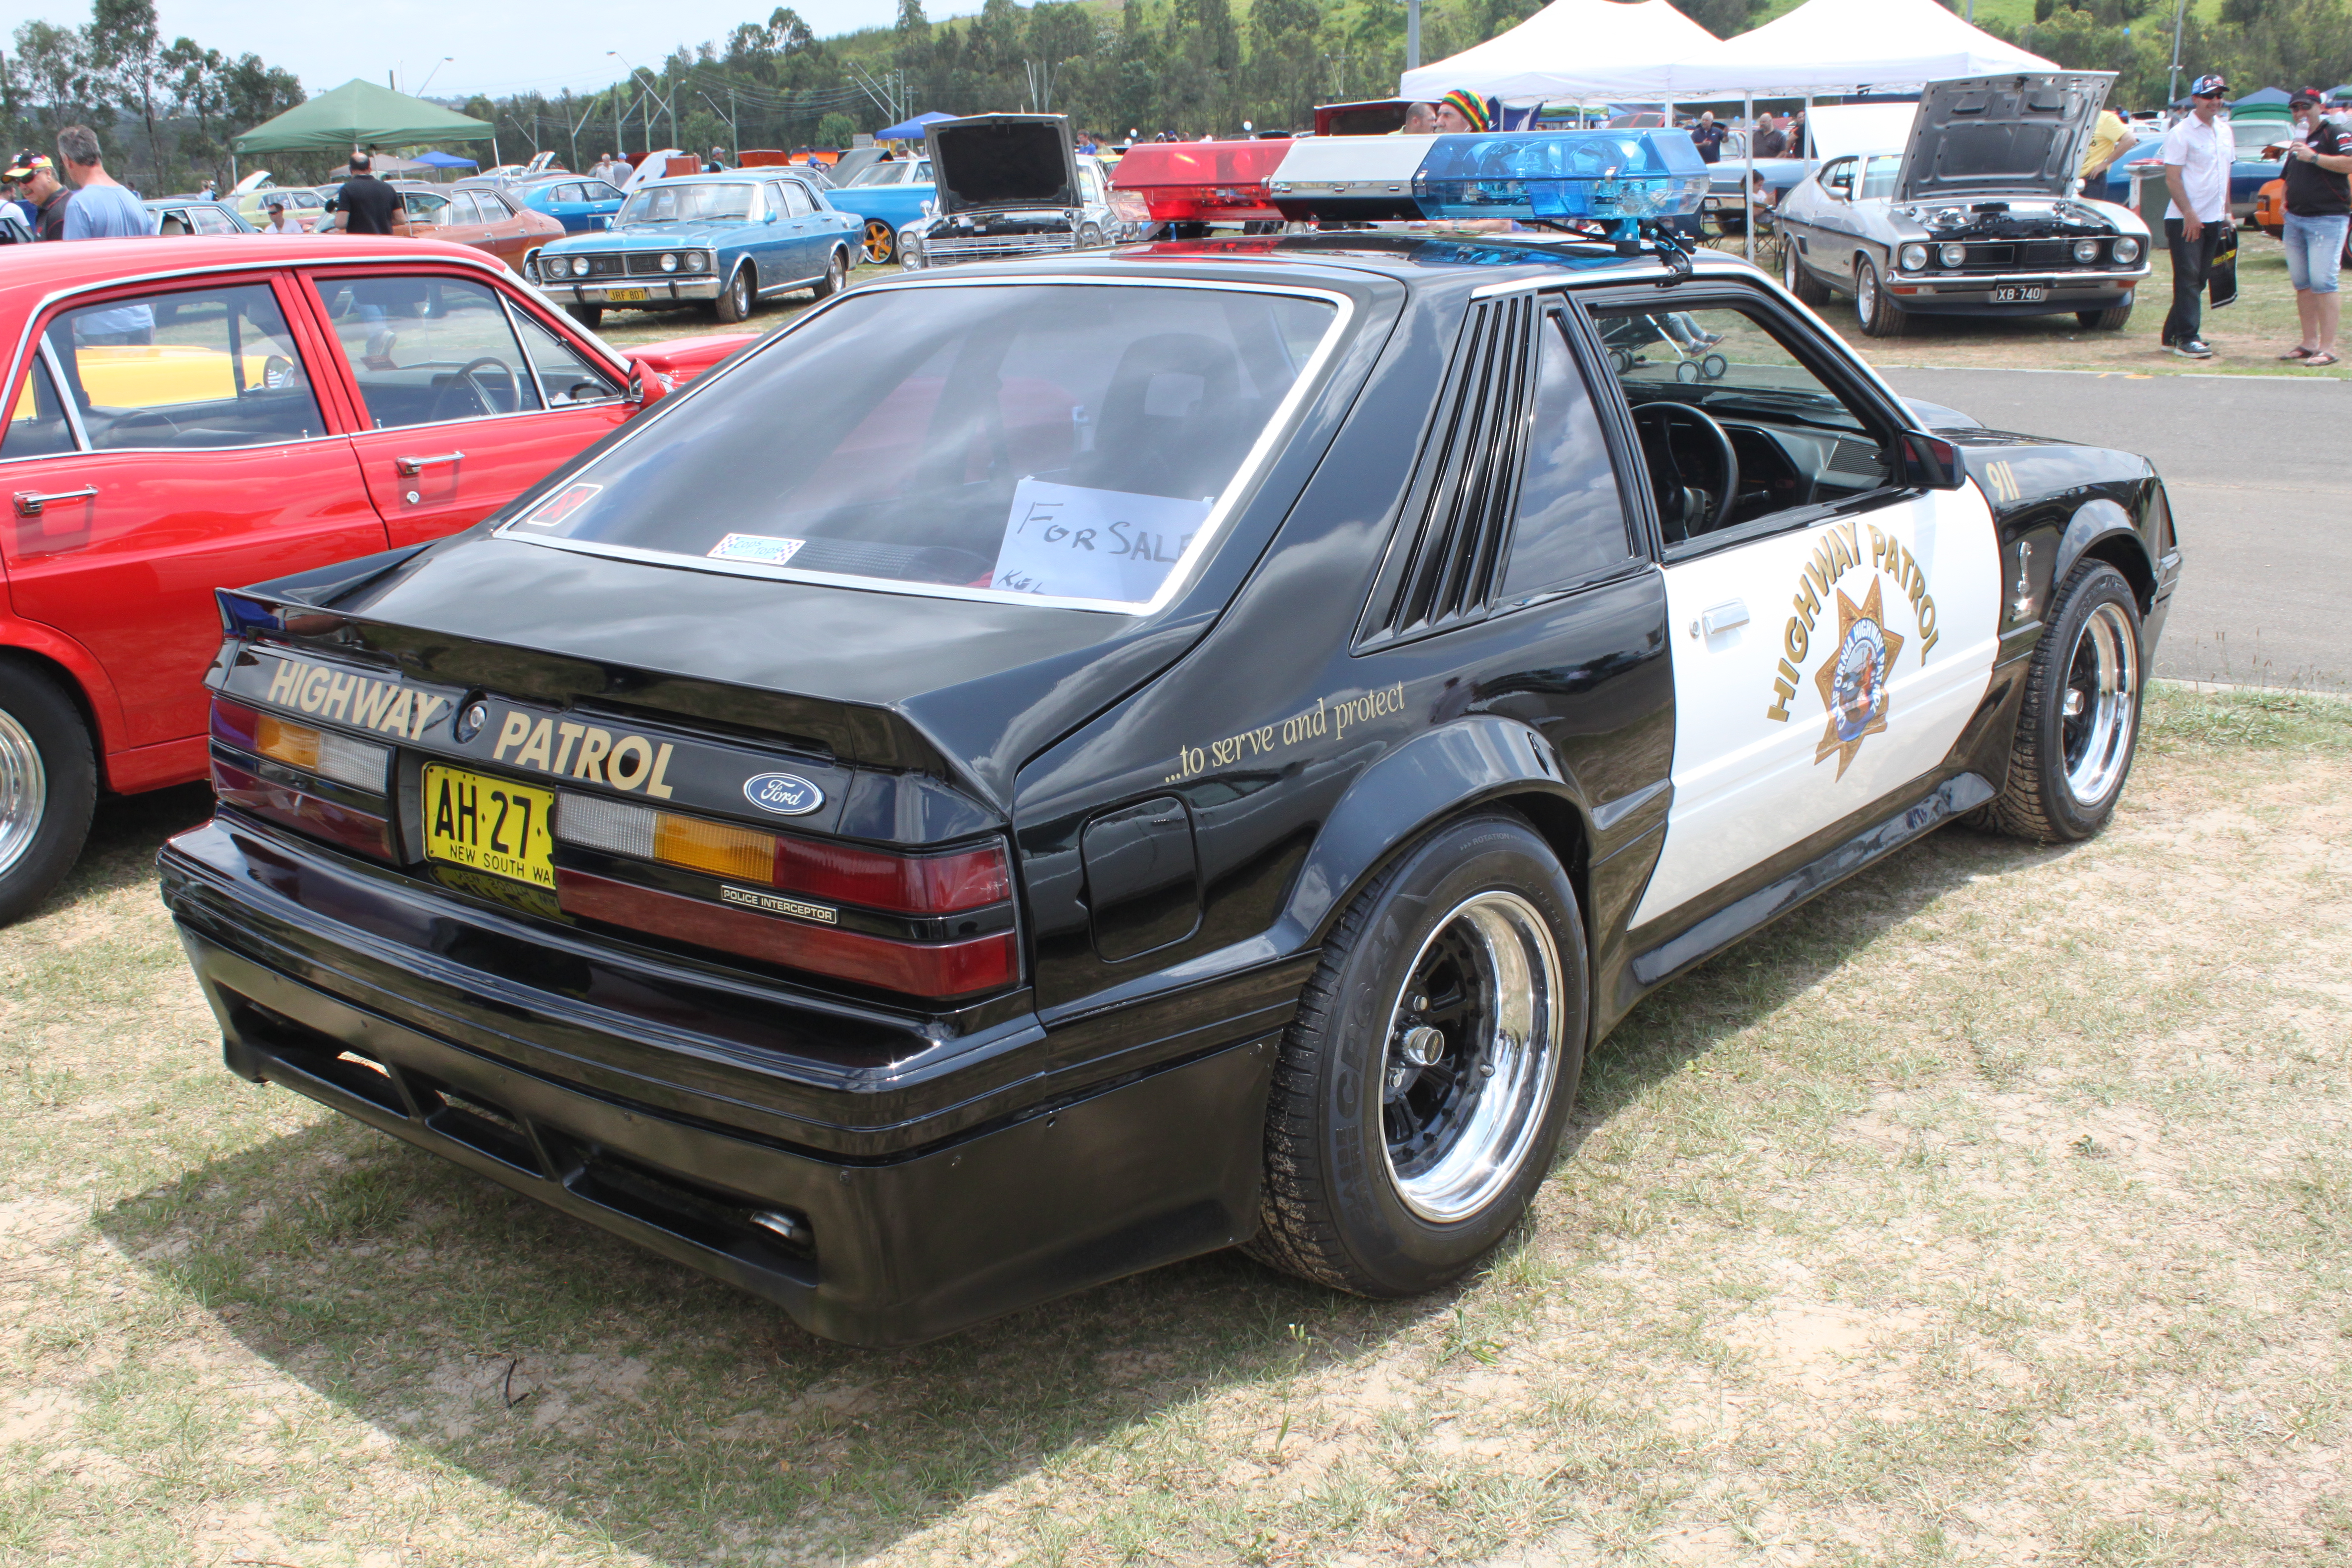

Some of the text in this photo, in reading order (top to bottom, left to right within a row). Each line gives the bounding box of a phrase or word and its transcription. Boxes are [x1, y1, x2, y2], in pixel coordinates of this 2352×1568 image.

[1985, 460, 2021, 503] 911
[734, 539, 764, 549] Cops
[1016, 501, 1097, 551] FOR
[754, 546, 783, 555] Tops
[1766, 522, 1939, 722] HIGHWAY PATROL
[1853, 619, 1884, 653] HIGHWAY
[1870, 652, 1885, 714] PATROL
[267, 659, 674, 799] HIGHWAY PATROL
[1212, 726, 1274, 768] serve
[1283, 697, 1327, 745] and
[1334, 681, 1405, 740] protect
[760, 779, 805, 806] Ford
[1472, 833, 1511, 845] ROTATION
[450, 843, 476, 863] NEW
[484, 853, 525, 877] SOUTH
[724, 889, 833, 921] POLICE INTERCEPTOR
